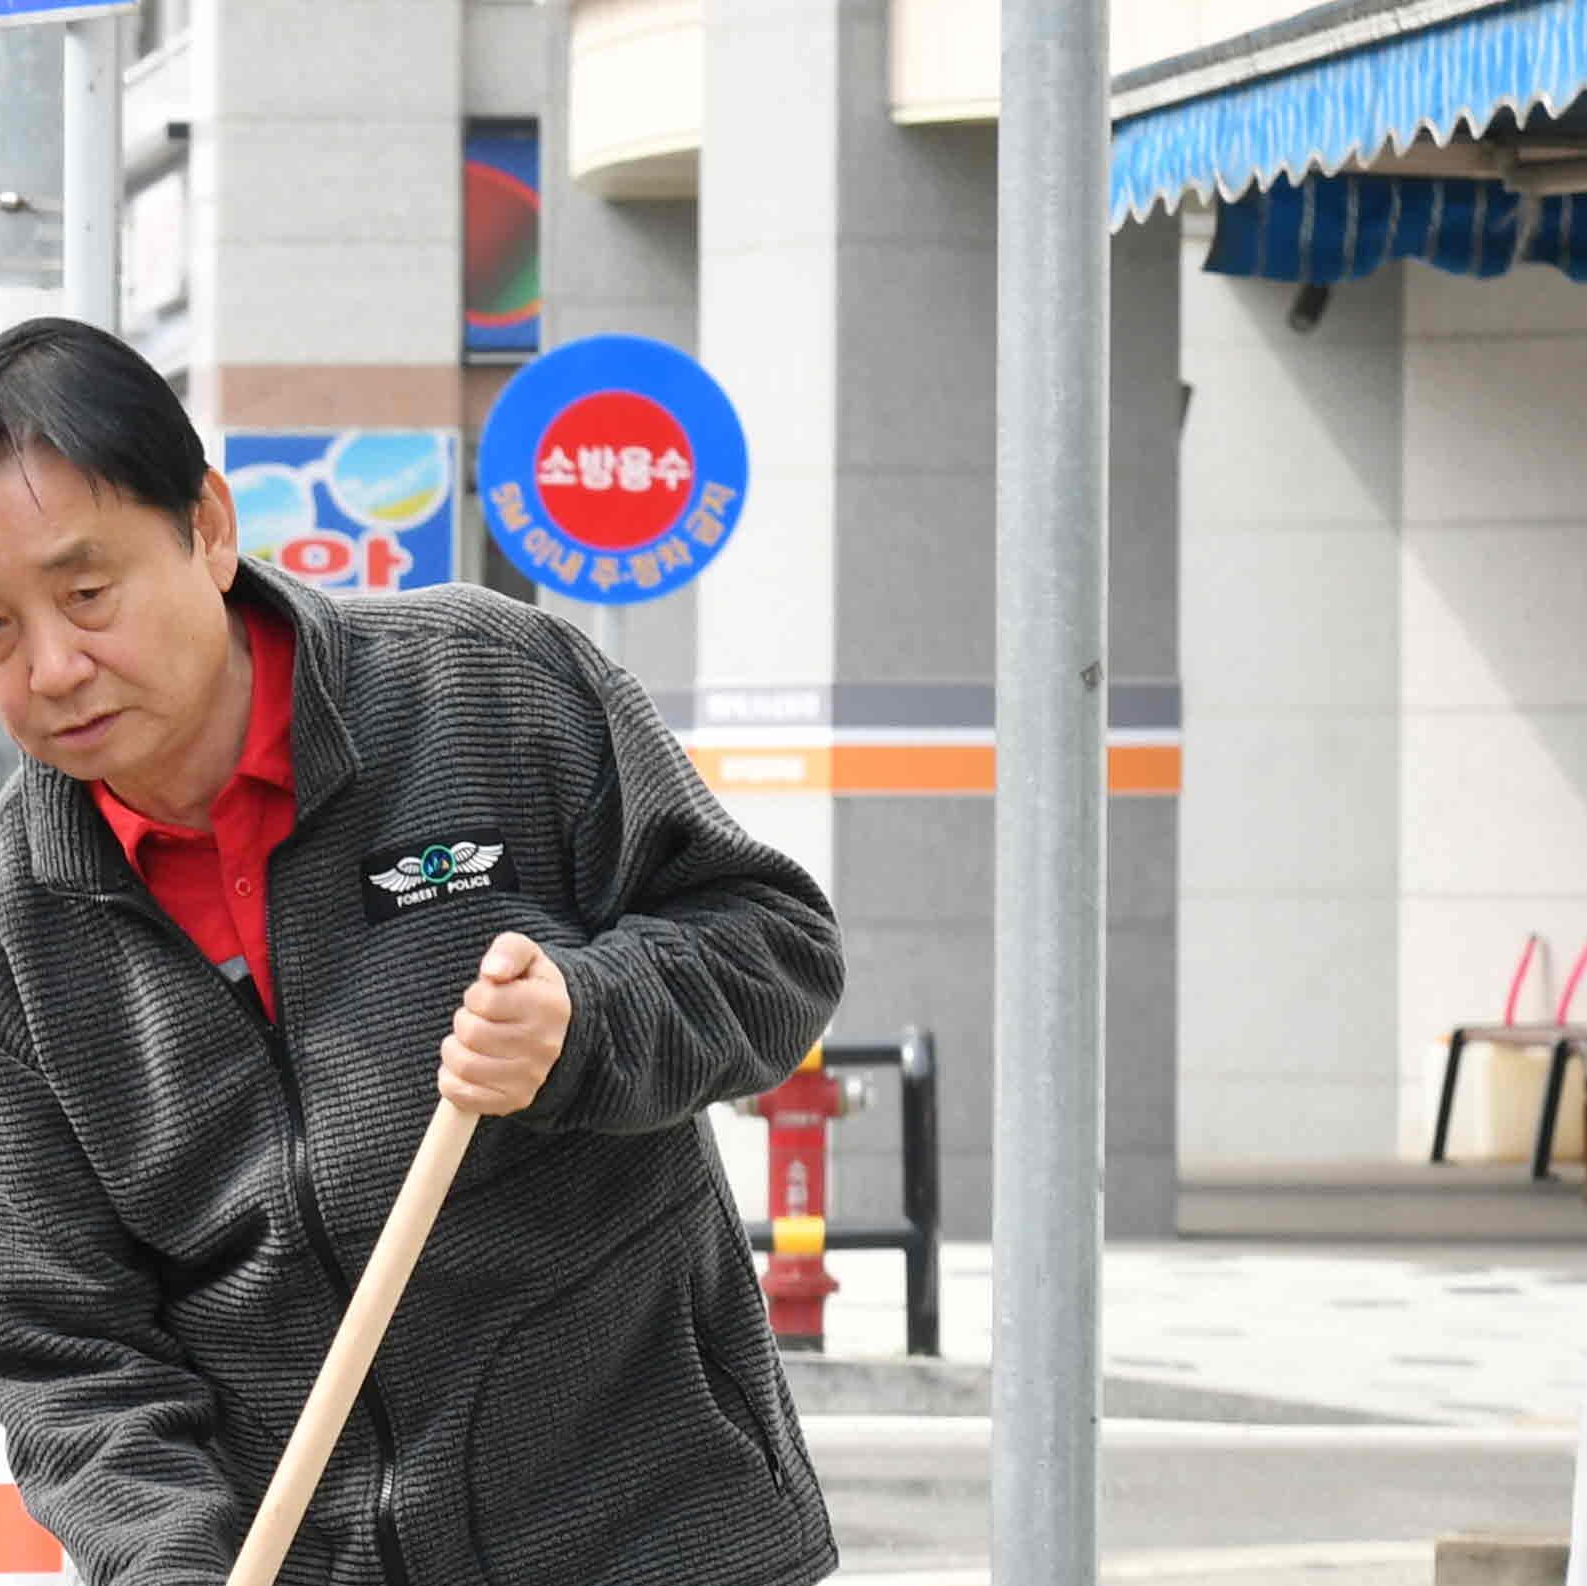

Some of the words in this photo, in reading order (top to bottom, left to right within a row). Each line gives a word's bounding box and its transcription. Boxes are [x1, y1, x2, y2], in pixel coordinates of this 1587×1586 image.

[537, 444, 692, 492] 소방용수
[522, 527, 585, 585] 이내
[685, 480, 738, 548] 금지
[396, 886, 439, 908] FOREST
[447, 874, 491, 894] POLICE
